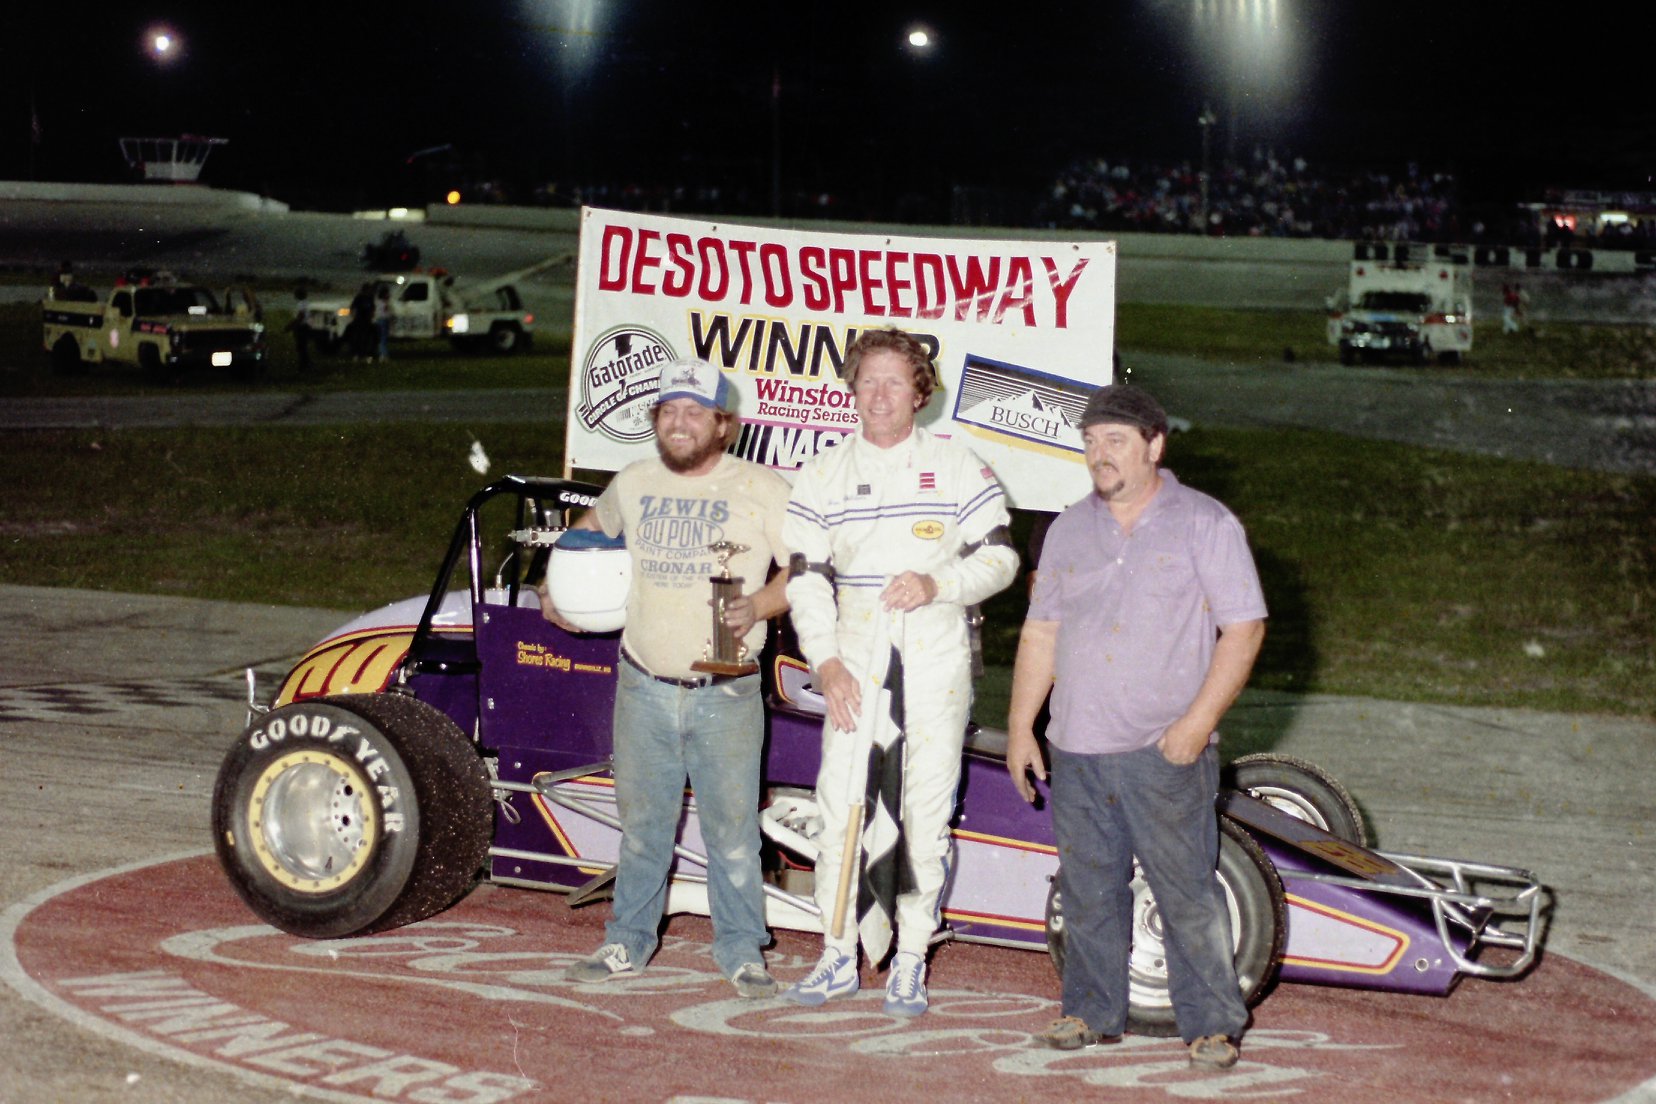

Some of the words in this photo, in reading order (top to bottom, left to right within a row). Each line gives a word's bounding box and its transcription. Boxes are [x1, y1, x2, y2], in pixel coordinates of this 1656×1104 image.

[590, 344, 664, 388] Gatorade
[587, 395, 618, 425] CIRCLE
[757, 402, 810, 424] Racing
[812, 407, 859, 423] Series
[991, 405, 1060, 437] BUSCH
[639, 496, 730, 523] LEWIS
[640, 559, 713, 575] CRONAR
[544, 653, 572, 672] Racing
[57, 969, 541, 1104] WINNERS
